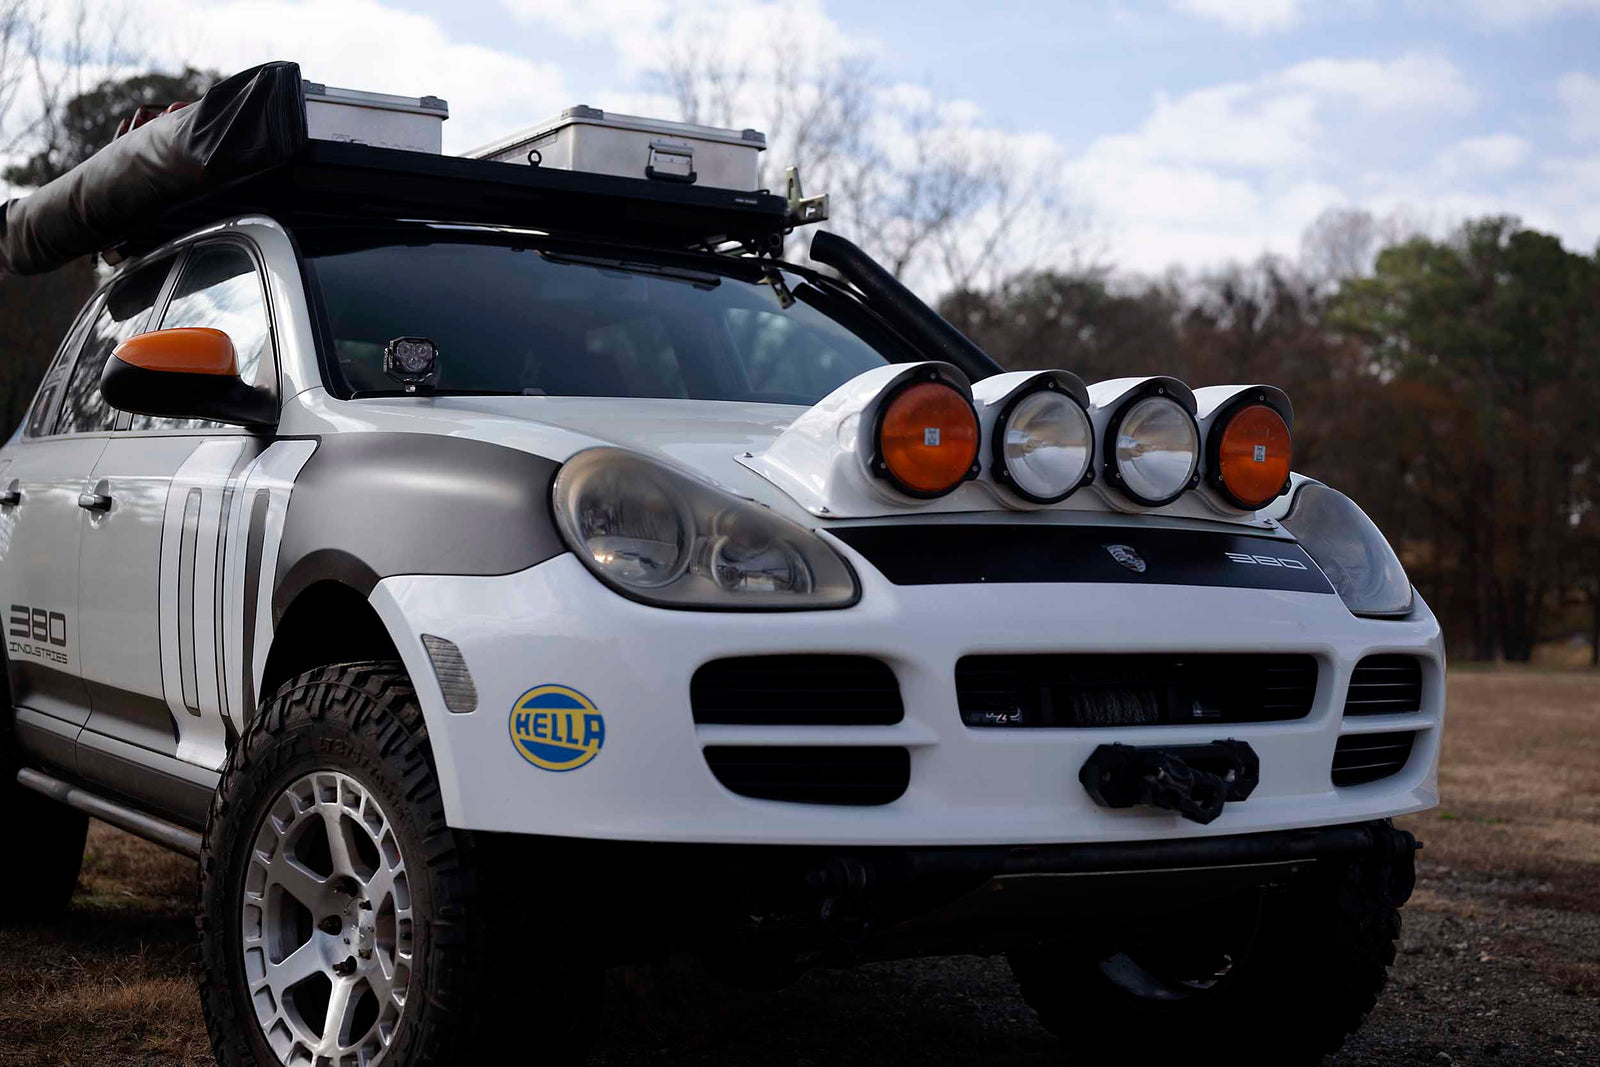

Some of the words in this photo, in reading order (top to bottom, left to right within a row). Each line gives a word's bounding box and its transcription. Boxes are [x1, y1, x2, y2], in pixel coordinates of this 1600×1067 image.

[1224, 552, 1308, 570] 380
[9, 604, 67, 647] 380
[9, 641, 68, 665] INDUSTRIES
[515, 713, 606, 749] HELLA
